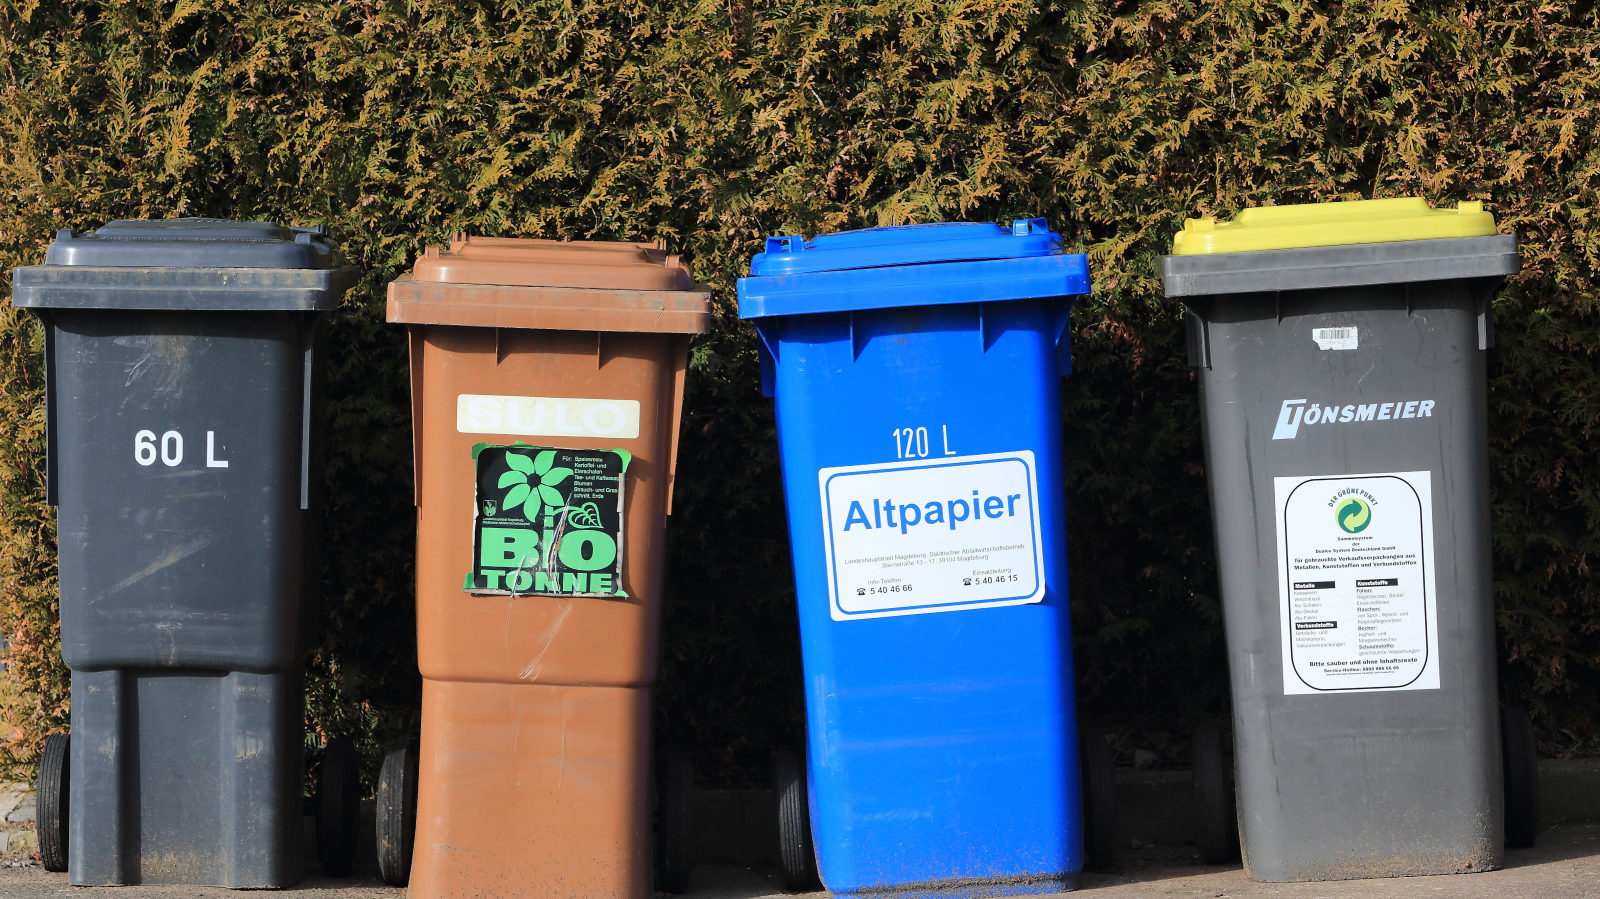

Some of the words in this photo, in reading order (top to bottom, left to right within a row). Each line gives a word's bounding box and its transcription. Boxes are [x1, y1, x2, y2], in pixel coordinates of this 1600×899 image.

[466, 397, 627, 435] SULO
[1272, 399, 1436, 440] TÖNSMEIER
[134, 429, 183, 467] 60
[206, 430, 228, 468] L
[892, 426, 929, 459] 120
[942, 424, 957, 455] L
[1327, 495, 1339, 507] DER
[1337, 487, 1359, 498] GRÜNE
[1359, 489, 1379, 506] PUNKT
[843, 490, 1021, 535] Altpapier
[844, 555, 894, 565] Landeshauptstadt
[929, 550, 960, 558] Städtischer
[961, 543, 1025, 555] Abfallwirtschaftsbetrieb
[882, 561, 915, 569] Sternstraße
[956, 554, 989, 562] Magdeburg
[1304, 556, 1337, 564] gebrauchte
[1338, 553, 1404, 562] Verkaufsverpackungen
[972, 567, 1012, 576] Einsatzleitung
[1373, 559, 1418, 567] Verbundstoffen
[481, 569, 612, 594] TONNE
[867, 577, 902, 585] Info-Telefon
[974, 577, 981, 585] 5
[982, 576, 993, 584] 40
[995, 575, 1006, 583] 46
[1007, 574, 1018, 582] 15
[1357, 579, 1389, 587] Kunststoffe
[870, 587, 876, 595] 5
[877, 586, 888, 594] 40
[890, 585, 901, 593] 46
[902, 584, 913, 592] 66
